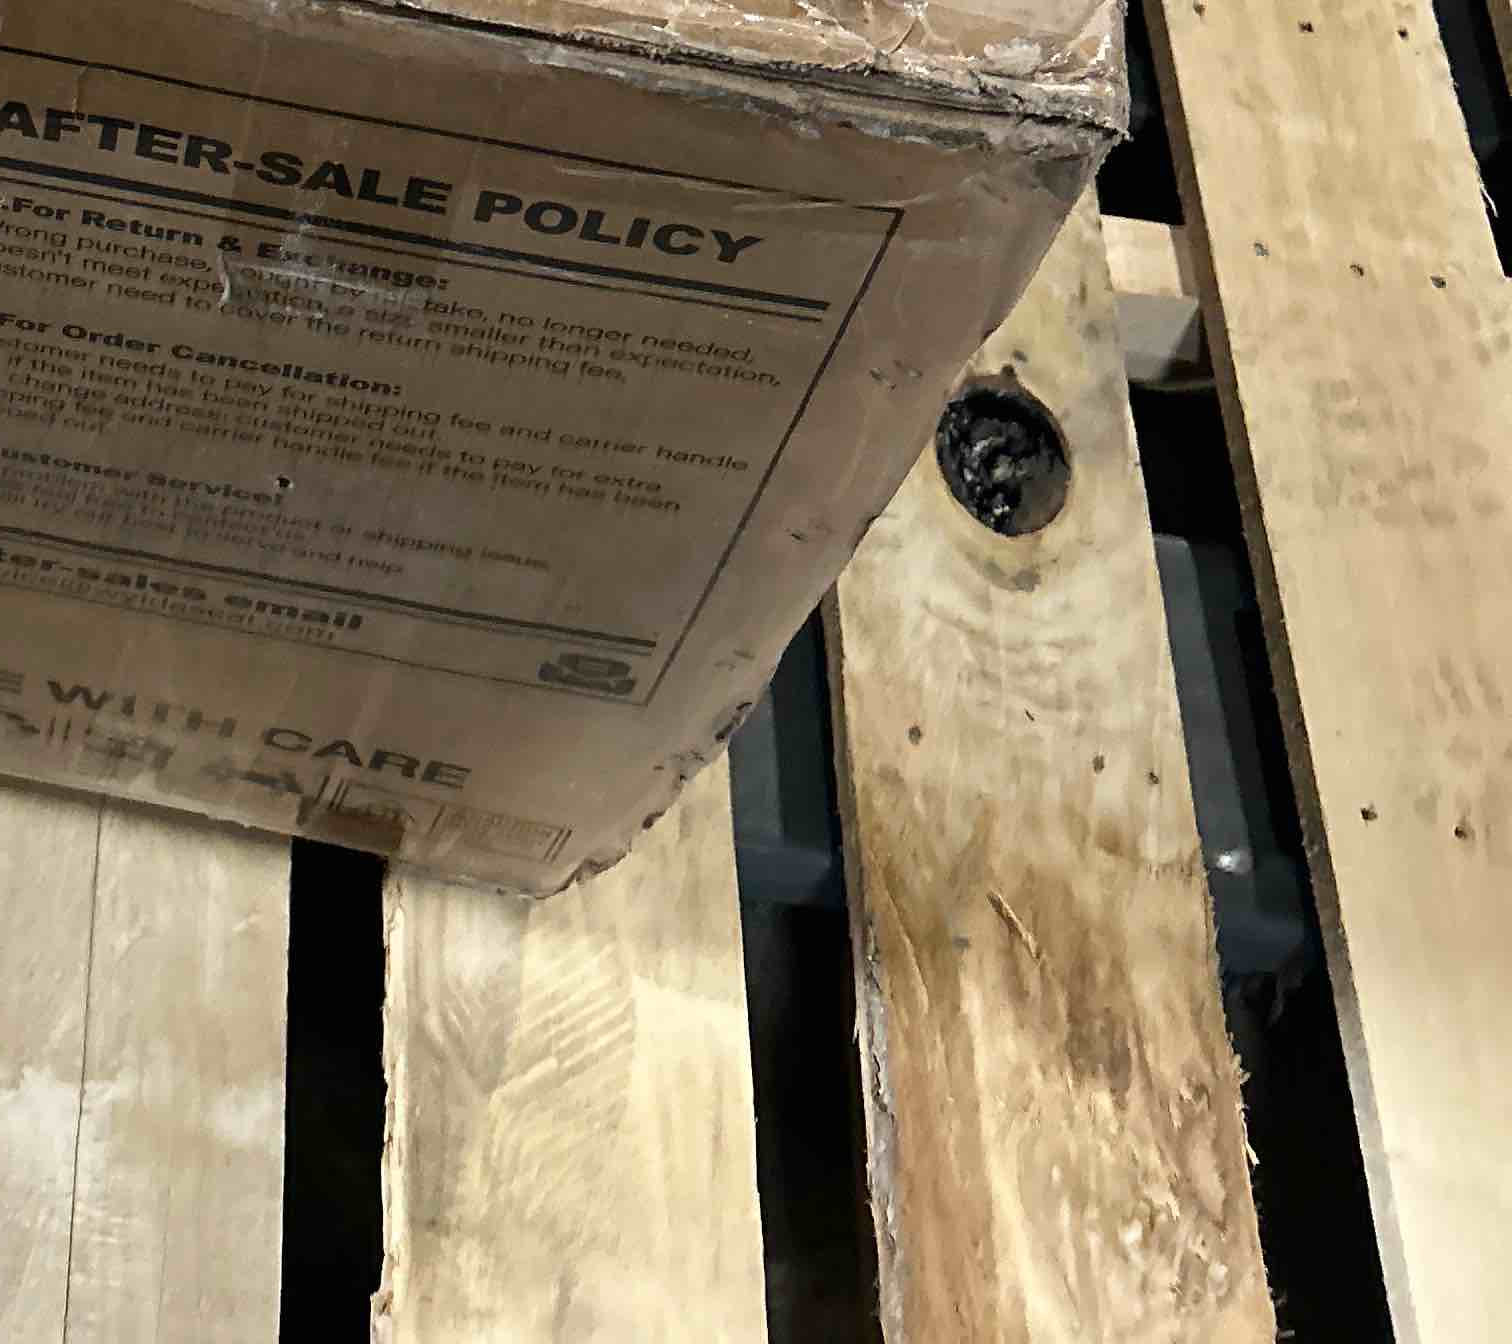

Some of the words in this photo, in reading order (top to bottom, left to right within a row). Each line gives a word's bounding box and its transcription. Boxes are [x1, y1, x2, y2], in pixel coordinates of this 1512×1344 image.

[80, 208, 204, 247] Return
[215, 234, 243, 254] &
[473, 189, 761, 263] POLICY
[81, 257, 151, 281] meet
[75, 235, 213, 273] purchase,
[541, 315, 633, 352] longer
[105, 282, 177, 306] need
[60, 322, 161, 354] Order
[263, 726, 473, 789] CARE
